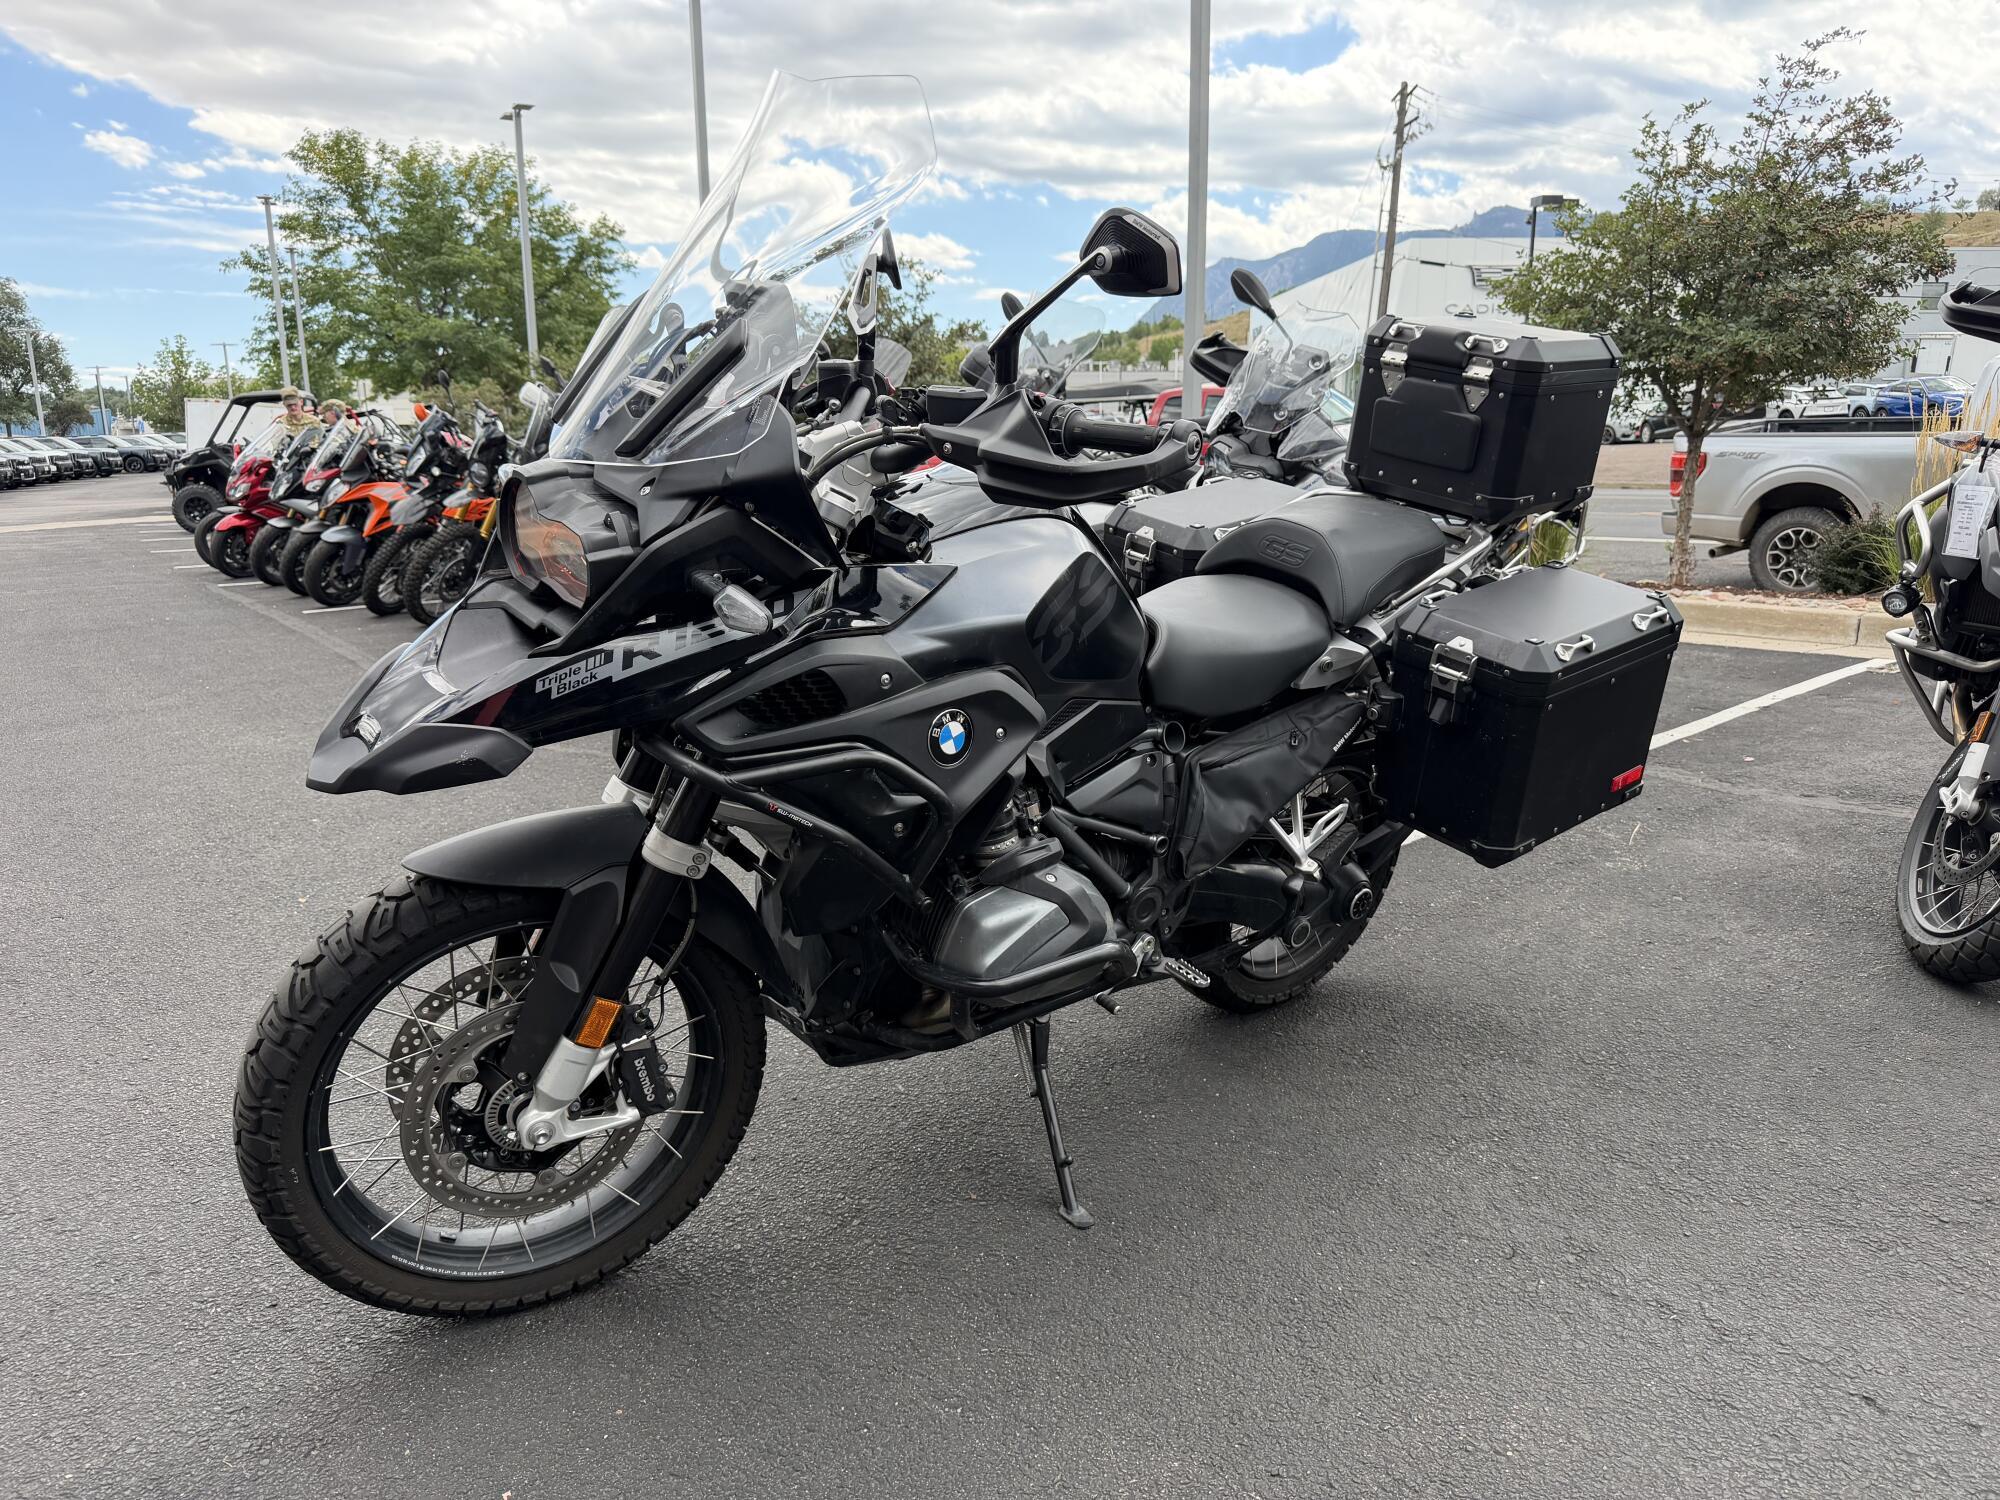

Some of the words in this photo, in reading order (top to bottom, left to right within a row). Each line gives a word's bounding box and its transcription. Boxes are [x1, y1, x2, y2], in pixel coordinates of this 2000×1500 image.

[1445, 303, 1504, 315] CADI
[1260, 535, 1312, 567] GS
[539, 665, 582, 689] Triple
[556, 671, 599, 696] Black
[931, 712, 967, 738] BMW
[1332, 737, 1345, 752] BMW
[633, 1056, 655, 1102] brembo
